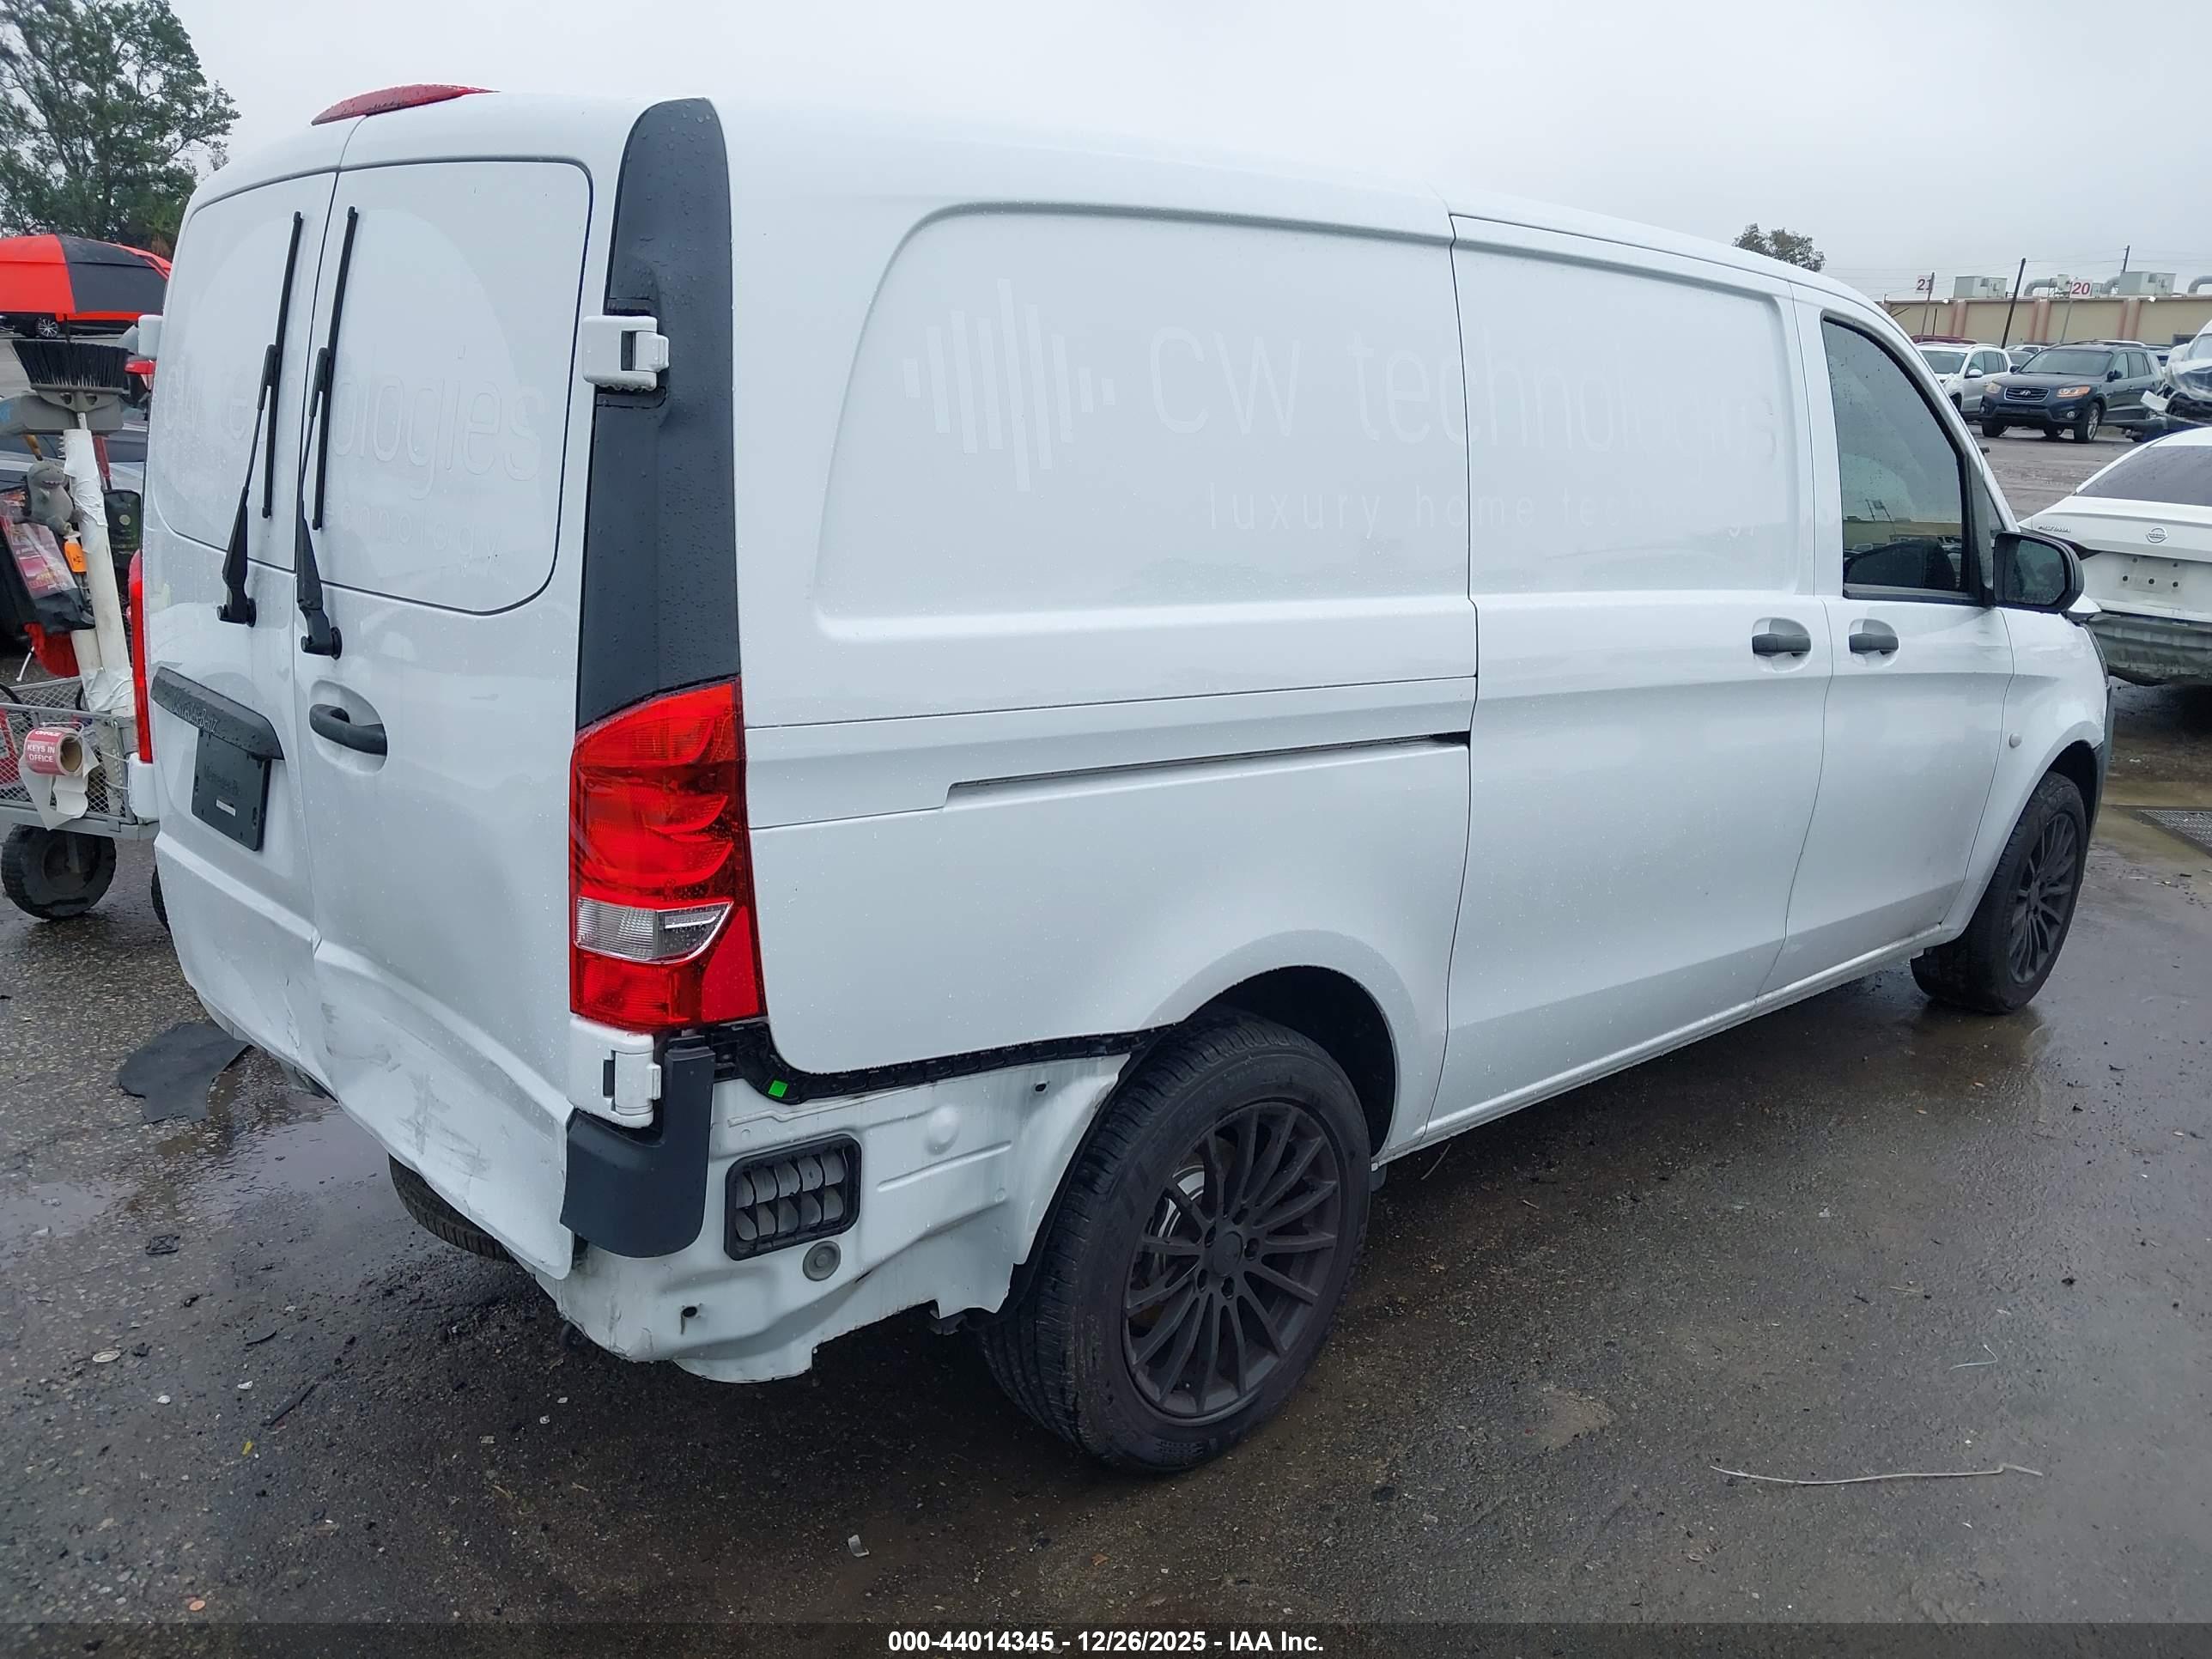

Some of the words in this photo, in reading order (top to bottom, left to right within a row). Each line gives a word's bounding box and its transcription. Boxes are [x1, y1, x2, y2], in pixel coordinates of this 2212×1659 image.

[2071, 282, 2091, 295] 20
[1150, 325, 1301, 438] CW
[1207, 481, 1381, 540] luxury
[1415, 480, 1540, 530] home
[27, 744, 46, 753] KEYS
[47, 745, 55, 754] IN
[28, 753, 54, 763] OFFICE
